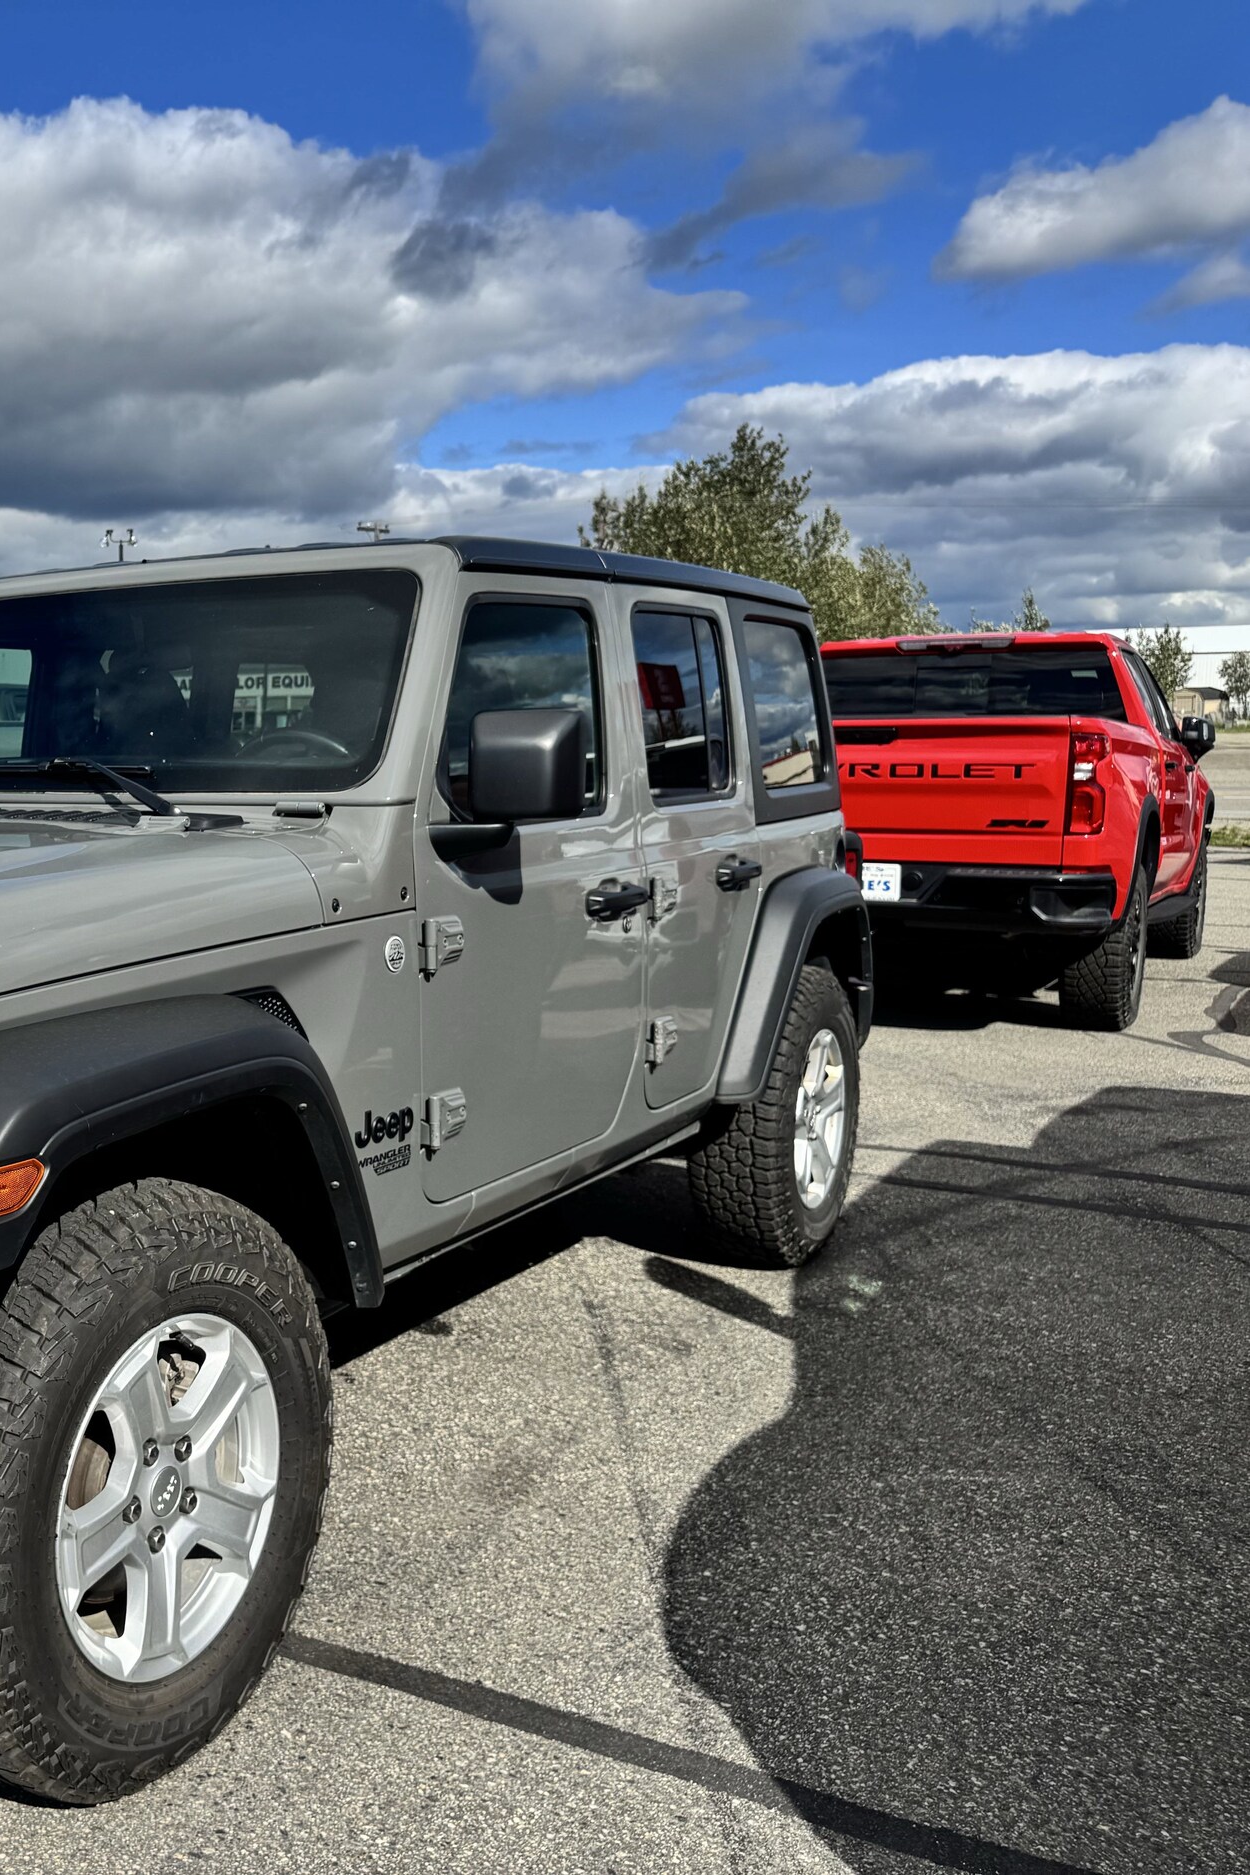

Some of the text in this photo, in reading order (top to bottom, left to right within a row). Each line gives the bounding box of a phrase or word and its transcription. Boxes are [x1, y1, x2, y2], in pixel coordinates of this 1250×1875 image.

[838, 763, 1036, 779] ROLET
[355, 1106, 414, 1149] Jeep
[358, 1144, 411, 1168] WRANGLER
[168, 1260, 293, 1329] COOPER
